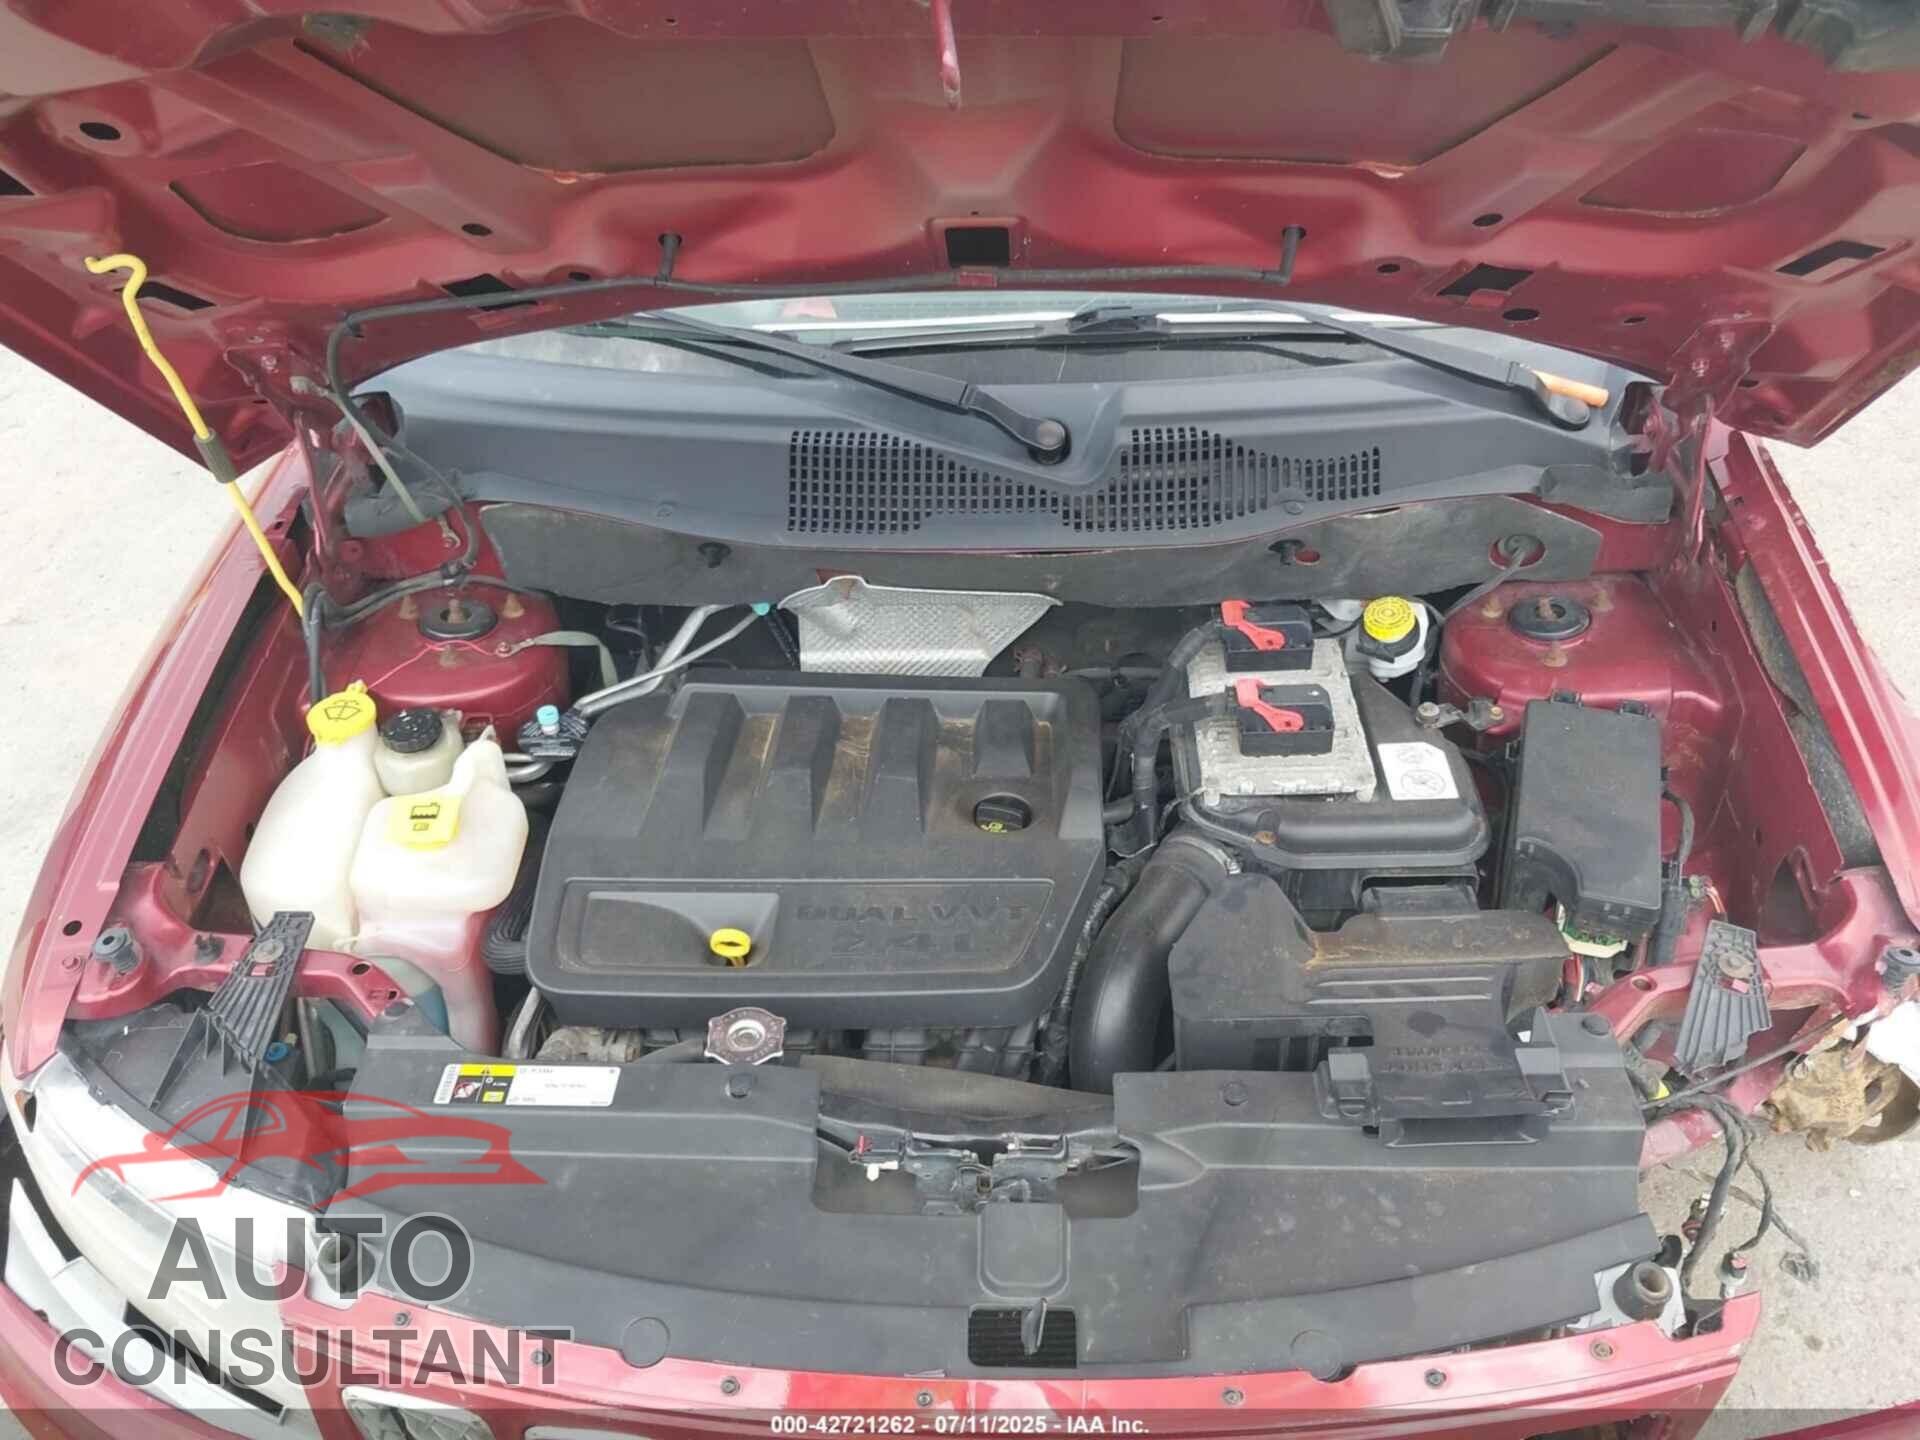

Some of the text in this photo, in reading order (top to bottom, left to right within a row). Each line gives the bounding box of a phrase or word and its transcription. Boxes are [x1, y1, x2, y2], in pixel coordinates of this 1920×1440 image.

[796, 904, 1029, 922] DUAL VVT
[831, 930, 977, 957] 24L
